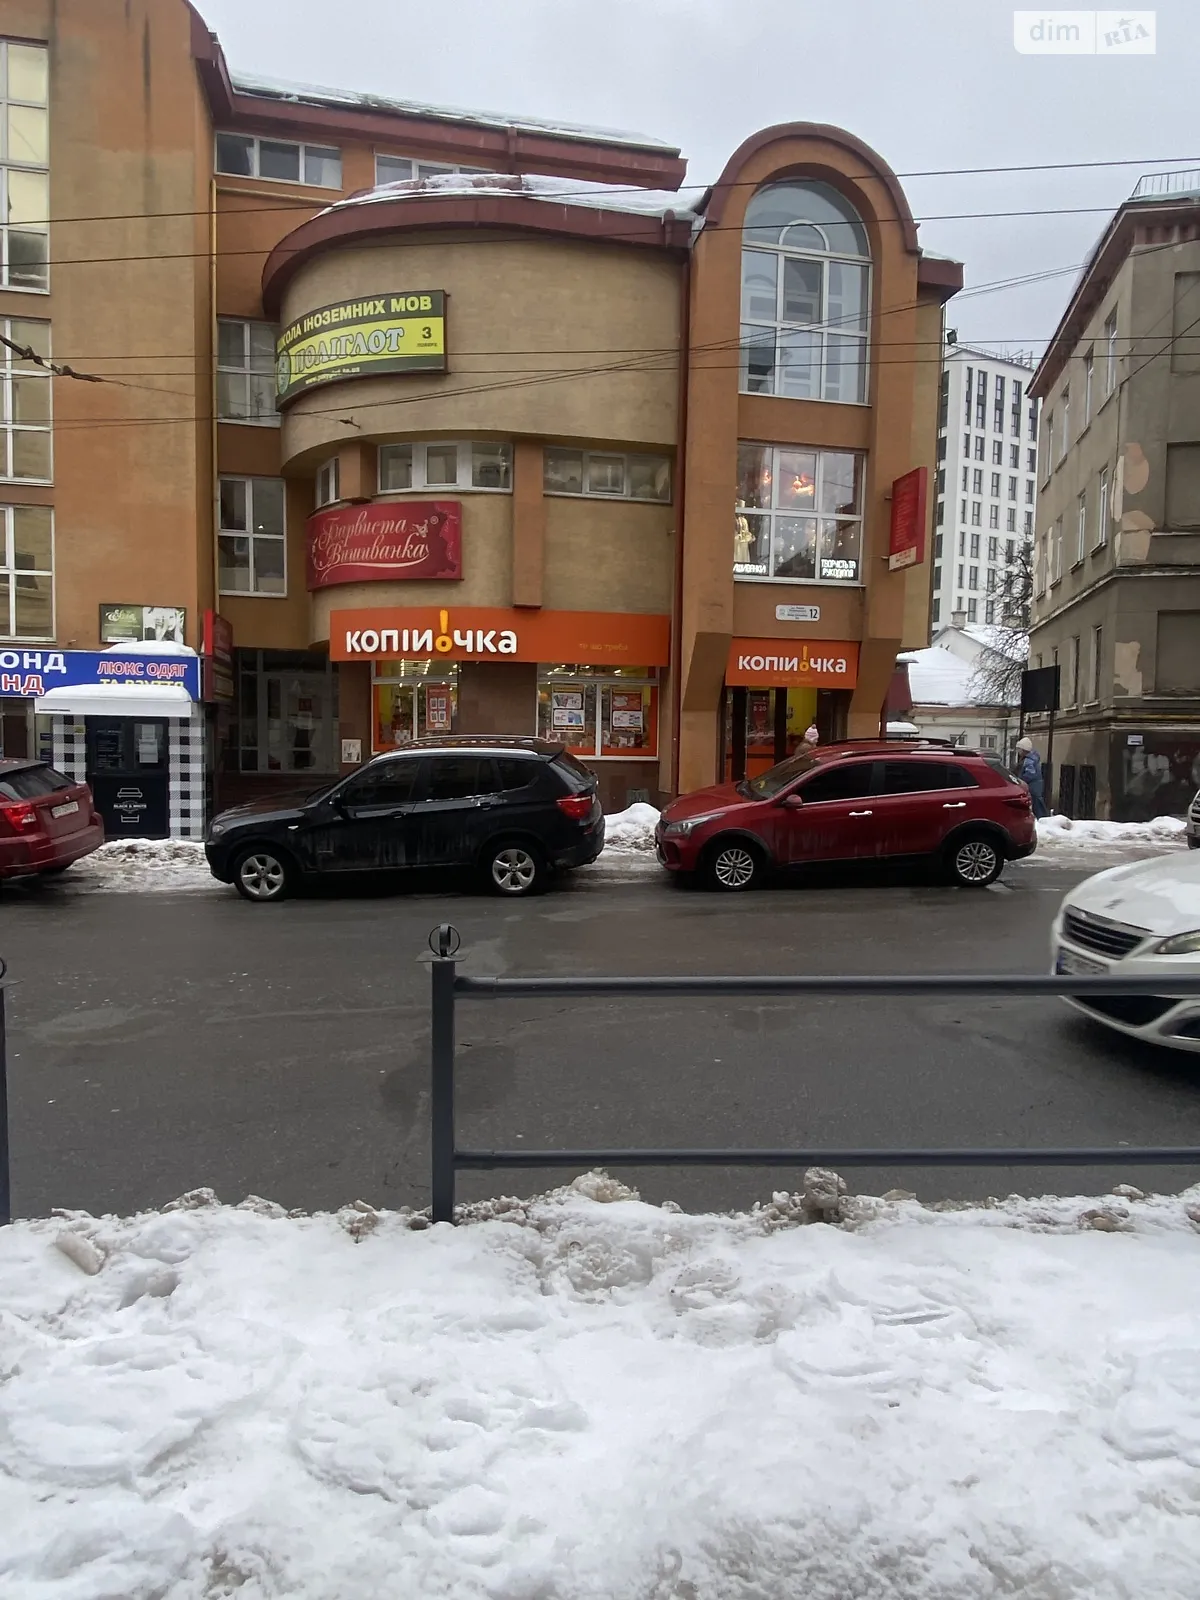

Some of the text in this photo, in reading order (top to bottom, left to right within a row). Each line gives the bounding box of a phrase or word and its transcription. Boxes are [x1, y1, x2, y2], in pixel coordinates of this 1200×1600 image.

[277, 295, 432, 351] КОЛА ІНОЗЕМНИХ МОВ
[422, 326, 432, 339] 3
[809, 608, 818, 619] 12
[97, 661, 188, 679] ЛЮКС ОДЯГ
